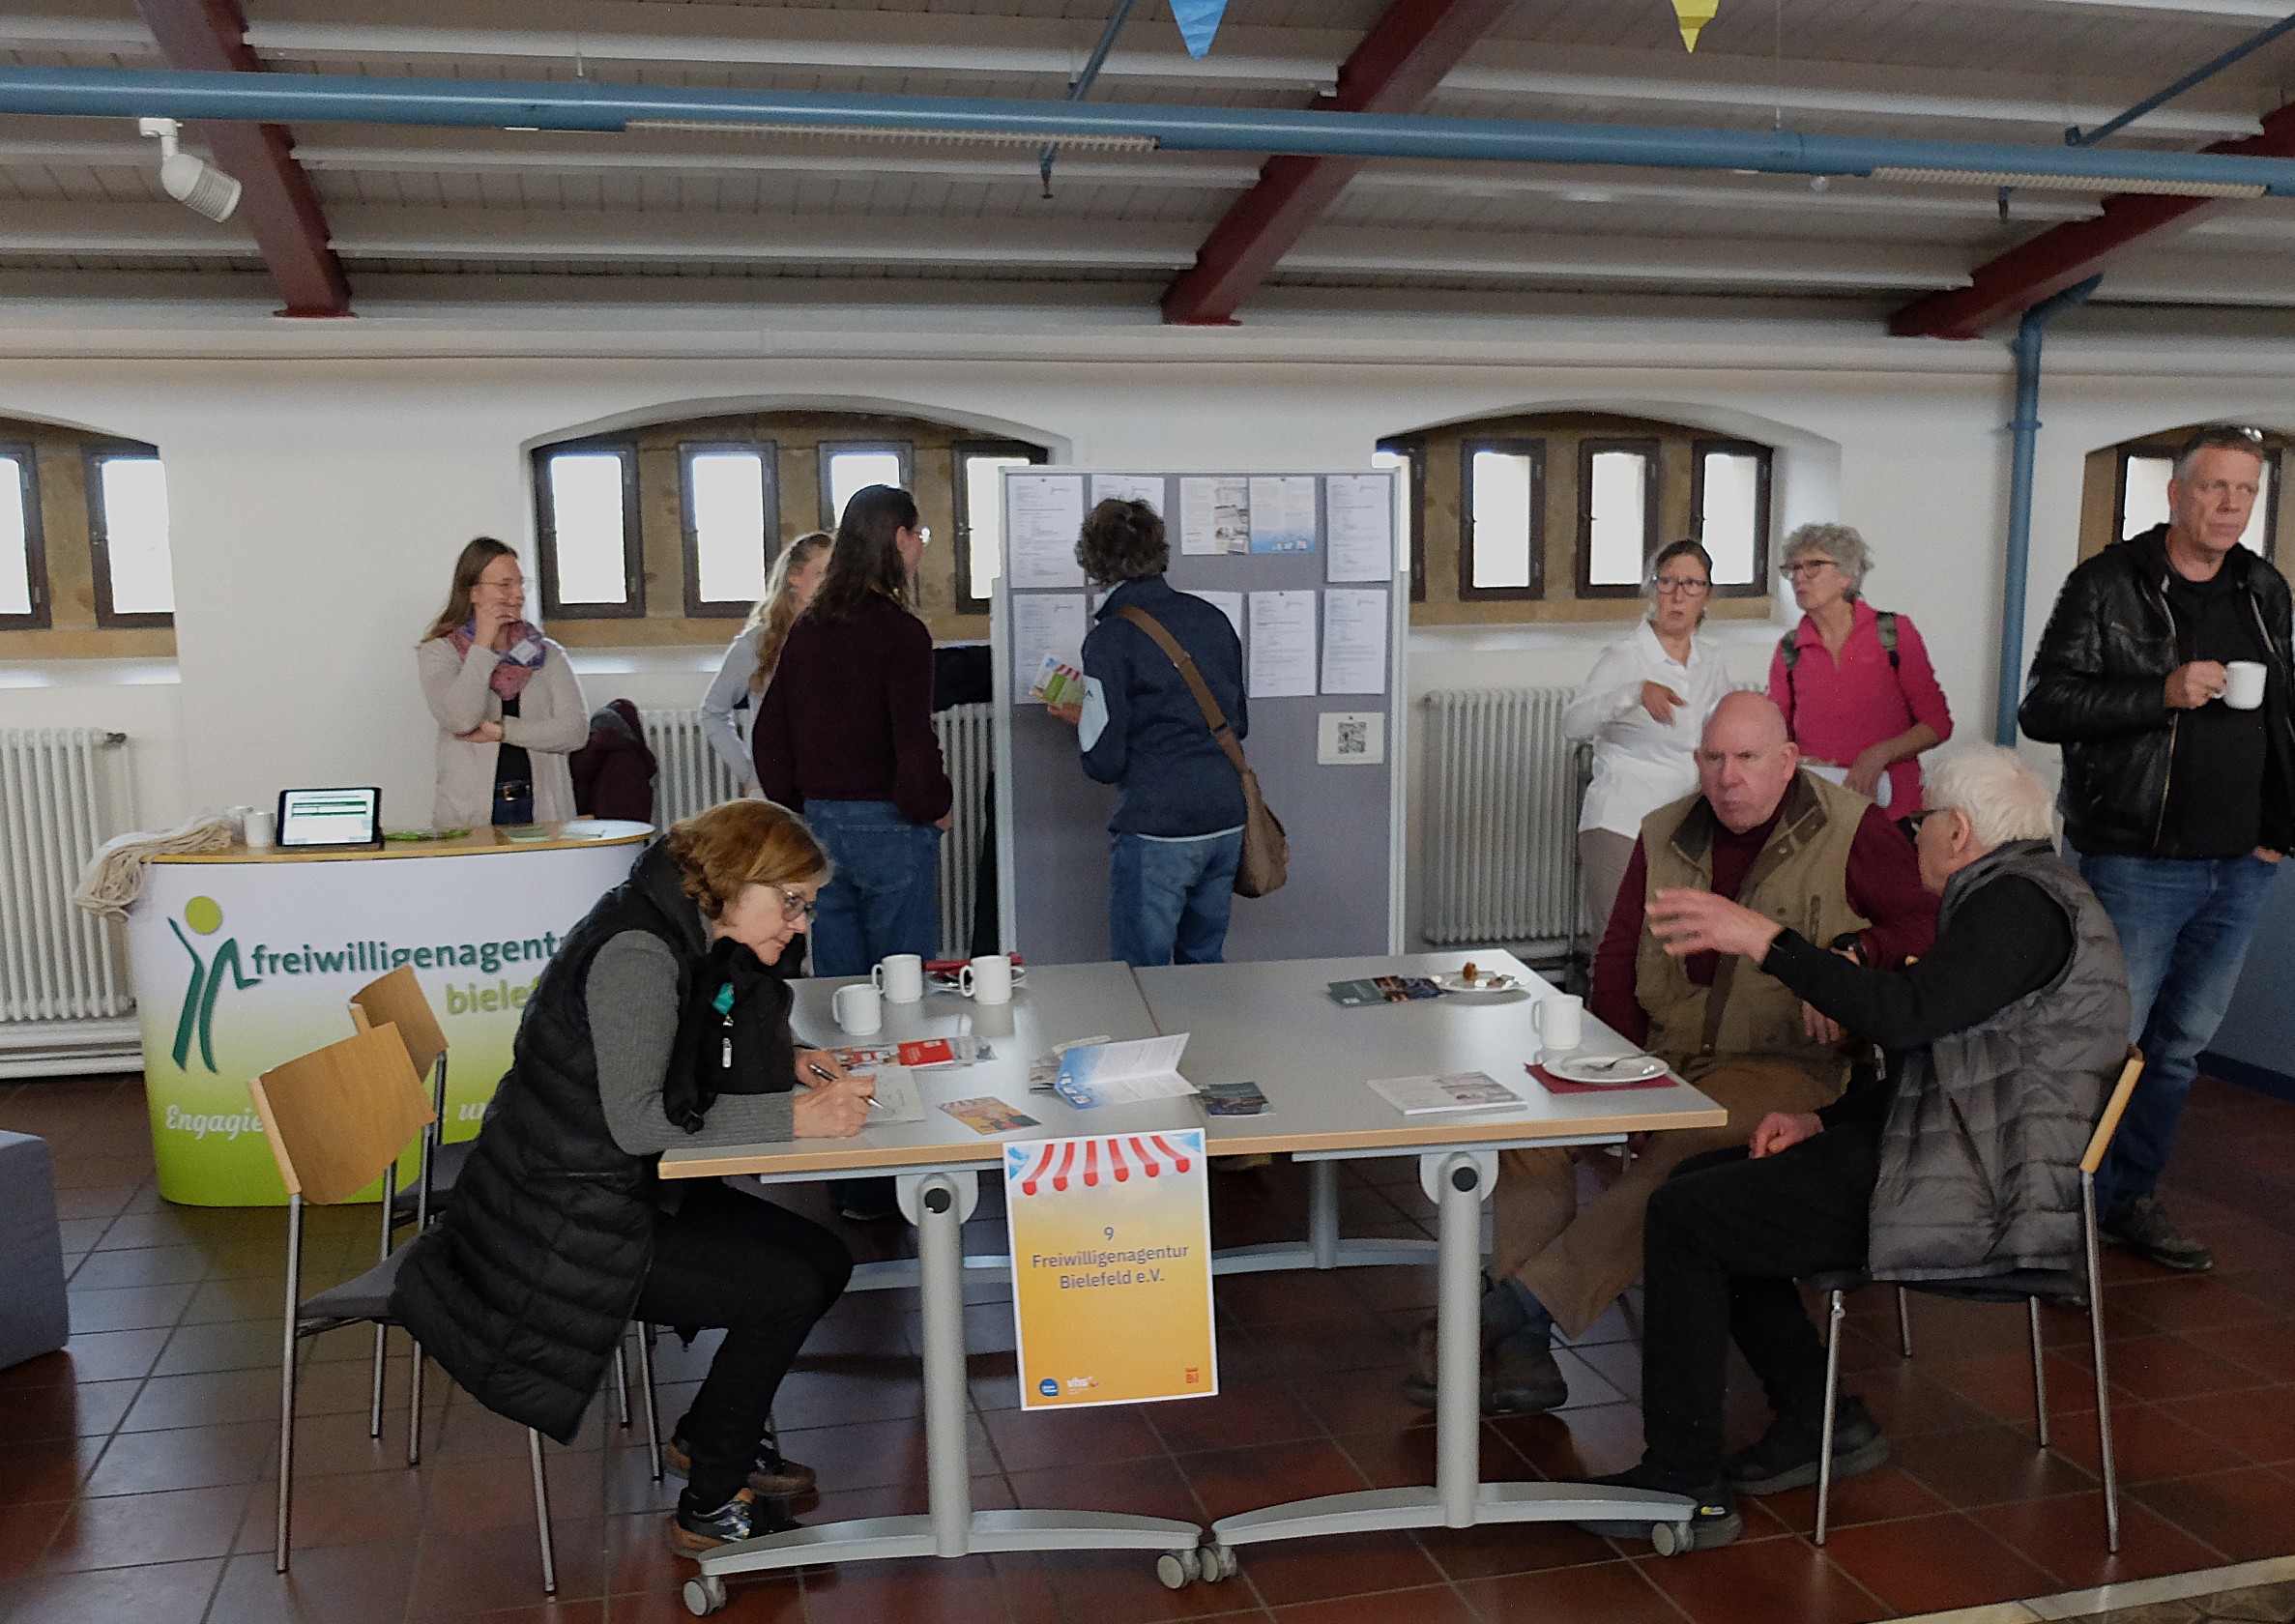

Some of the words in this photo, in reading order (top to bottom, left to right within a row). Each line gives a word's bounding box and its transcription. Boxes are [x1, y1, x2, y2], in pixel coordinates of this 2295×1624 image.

[251, 931, 564, 975] freiwilligenagent
[1104, 1227, 1115, 1240] 9
[1032, 1245, 1189, 1268] Freiwilligenagentur
[1060, 1269, 1131, 1289] Bielefeld
[1136, 1268, 1165, 1283] e.V.
